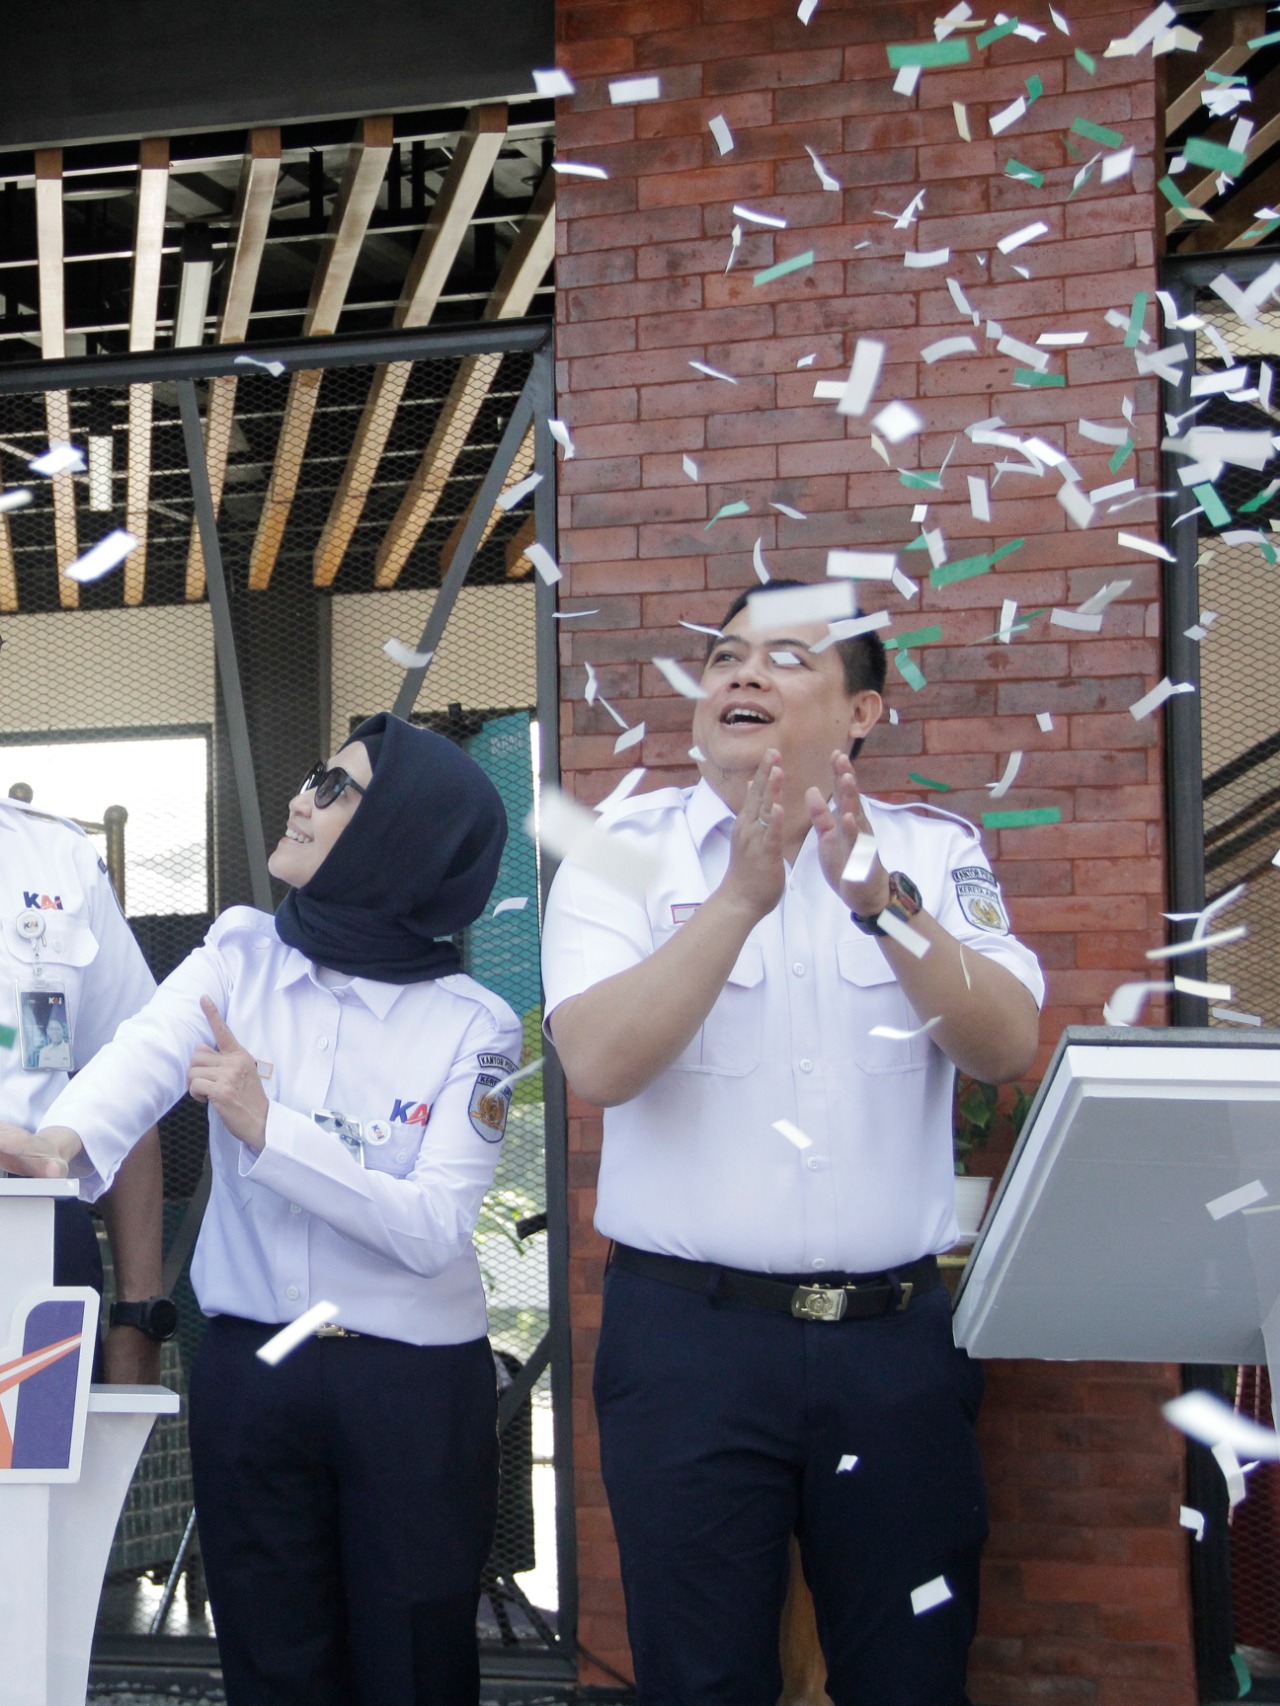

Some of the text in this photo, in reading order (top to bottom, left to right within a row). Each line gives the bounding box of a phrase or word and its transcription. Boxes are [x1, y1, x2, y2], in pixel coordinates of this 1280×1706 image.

[23, 891, 64, 910] KAI
[23, 920, 39, 930] KAI
[480, 1056, 504, 1066] KANTOR
